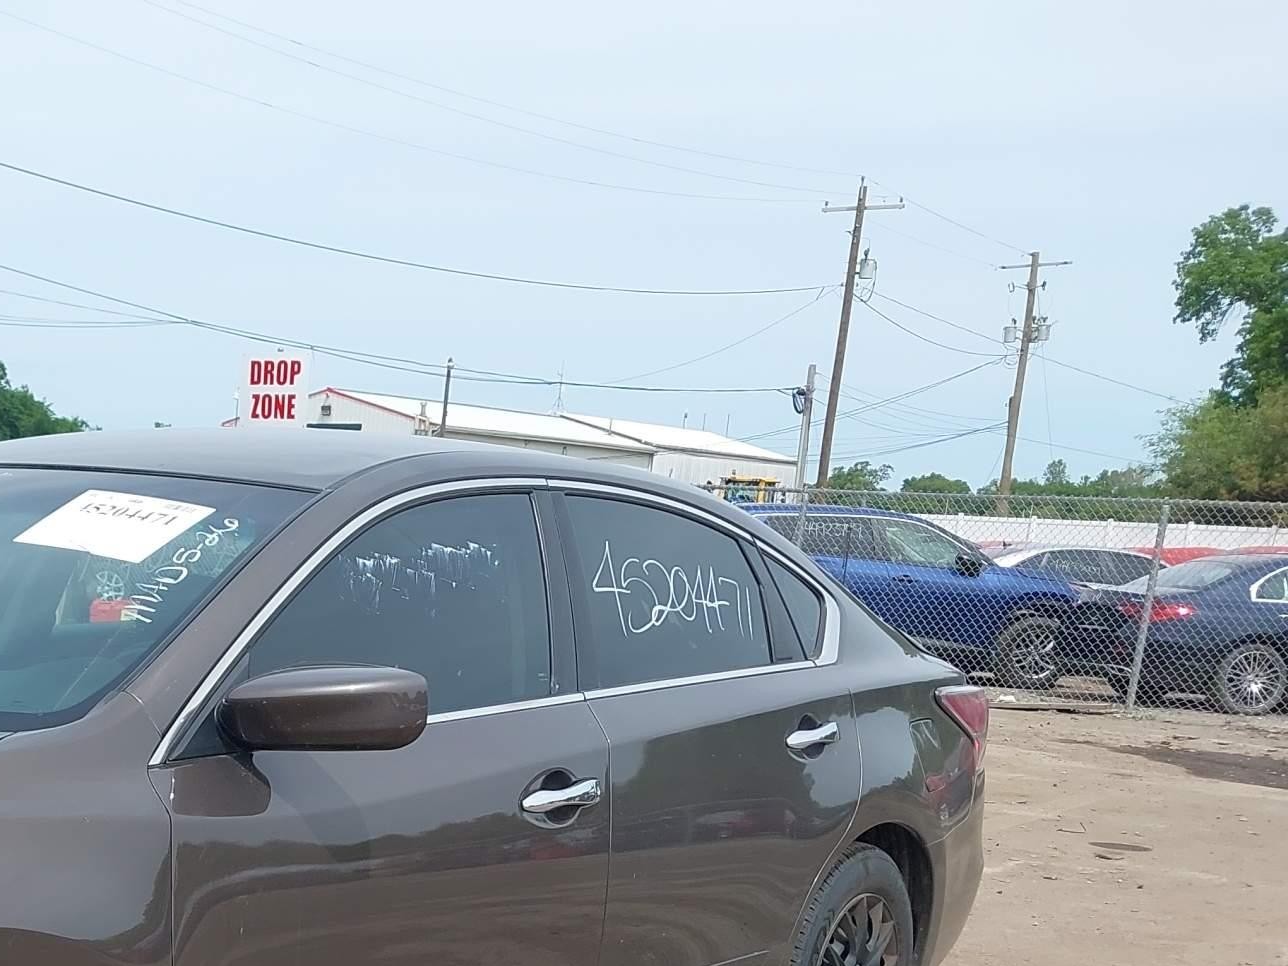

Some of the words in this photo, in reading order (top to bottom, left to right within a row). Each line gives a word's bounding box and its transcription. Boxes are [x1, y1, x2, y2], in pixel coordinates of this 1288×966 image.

[250, 360, 301, 386] DROP
[251, 394, 296, 419] ZONE
[592, 540, 754, 640] 45204471
